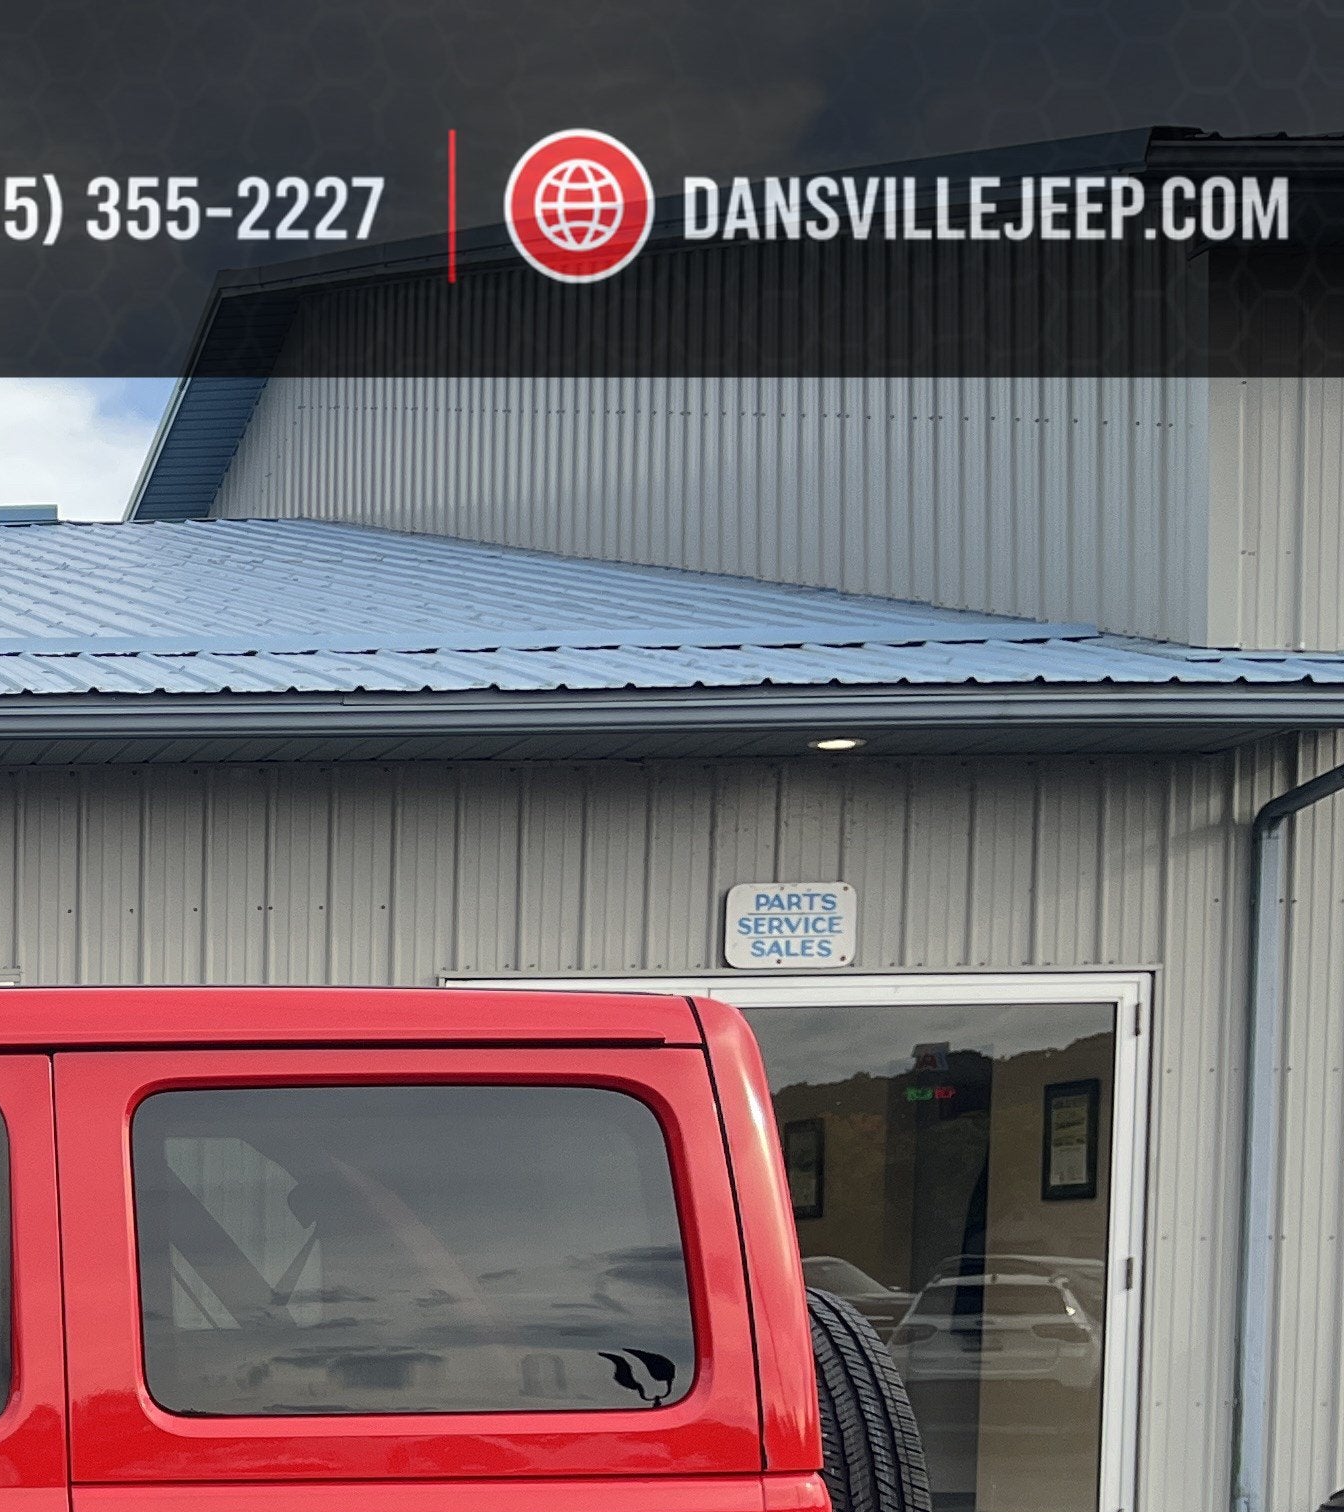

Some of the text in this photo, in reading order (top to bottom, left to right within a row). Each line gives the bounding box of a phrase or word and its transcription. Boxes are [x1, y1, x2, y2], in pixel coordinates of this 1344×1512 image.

[755, 893, 838, 911] PARTS
[737, 916, 843, 935] SERVICE
[750, 939, 832, 957] SALES
